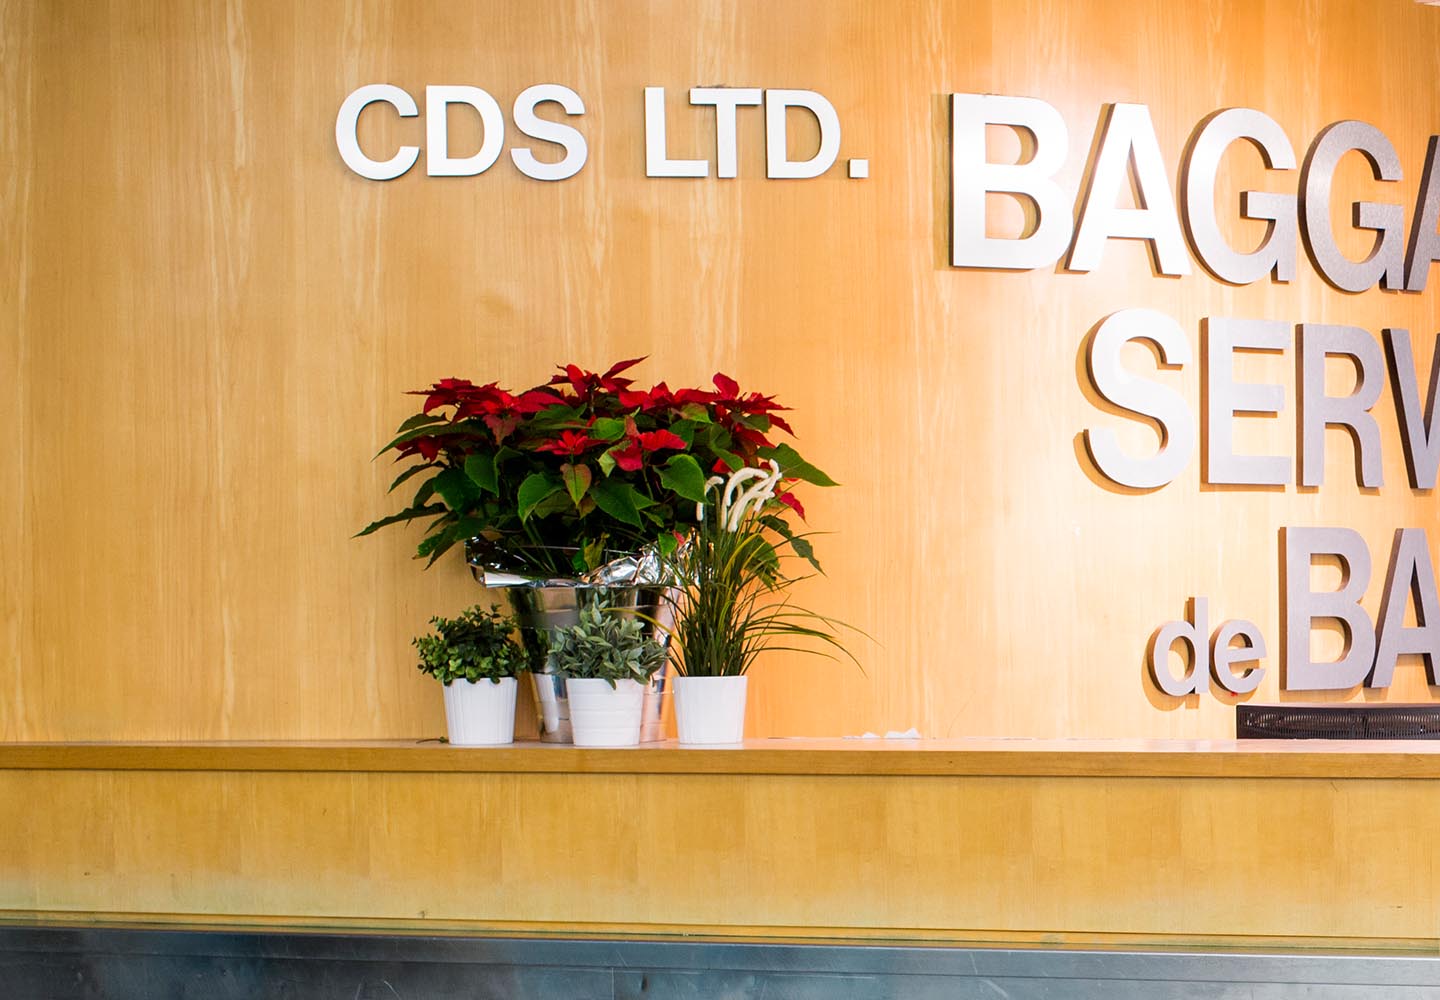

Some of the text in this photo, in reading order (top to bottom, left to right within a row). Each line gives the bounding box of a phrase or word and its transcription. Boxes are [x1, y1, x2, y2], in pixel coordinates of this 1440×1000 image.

[335, 83, 869, 181] CDS LTD.
[1147, 596, 1268, 697] de
